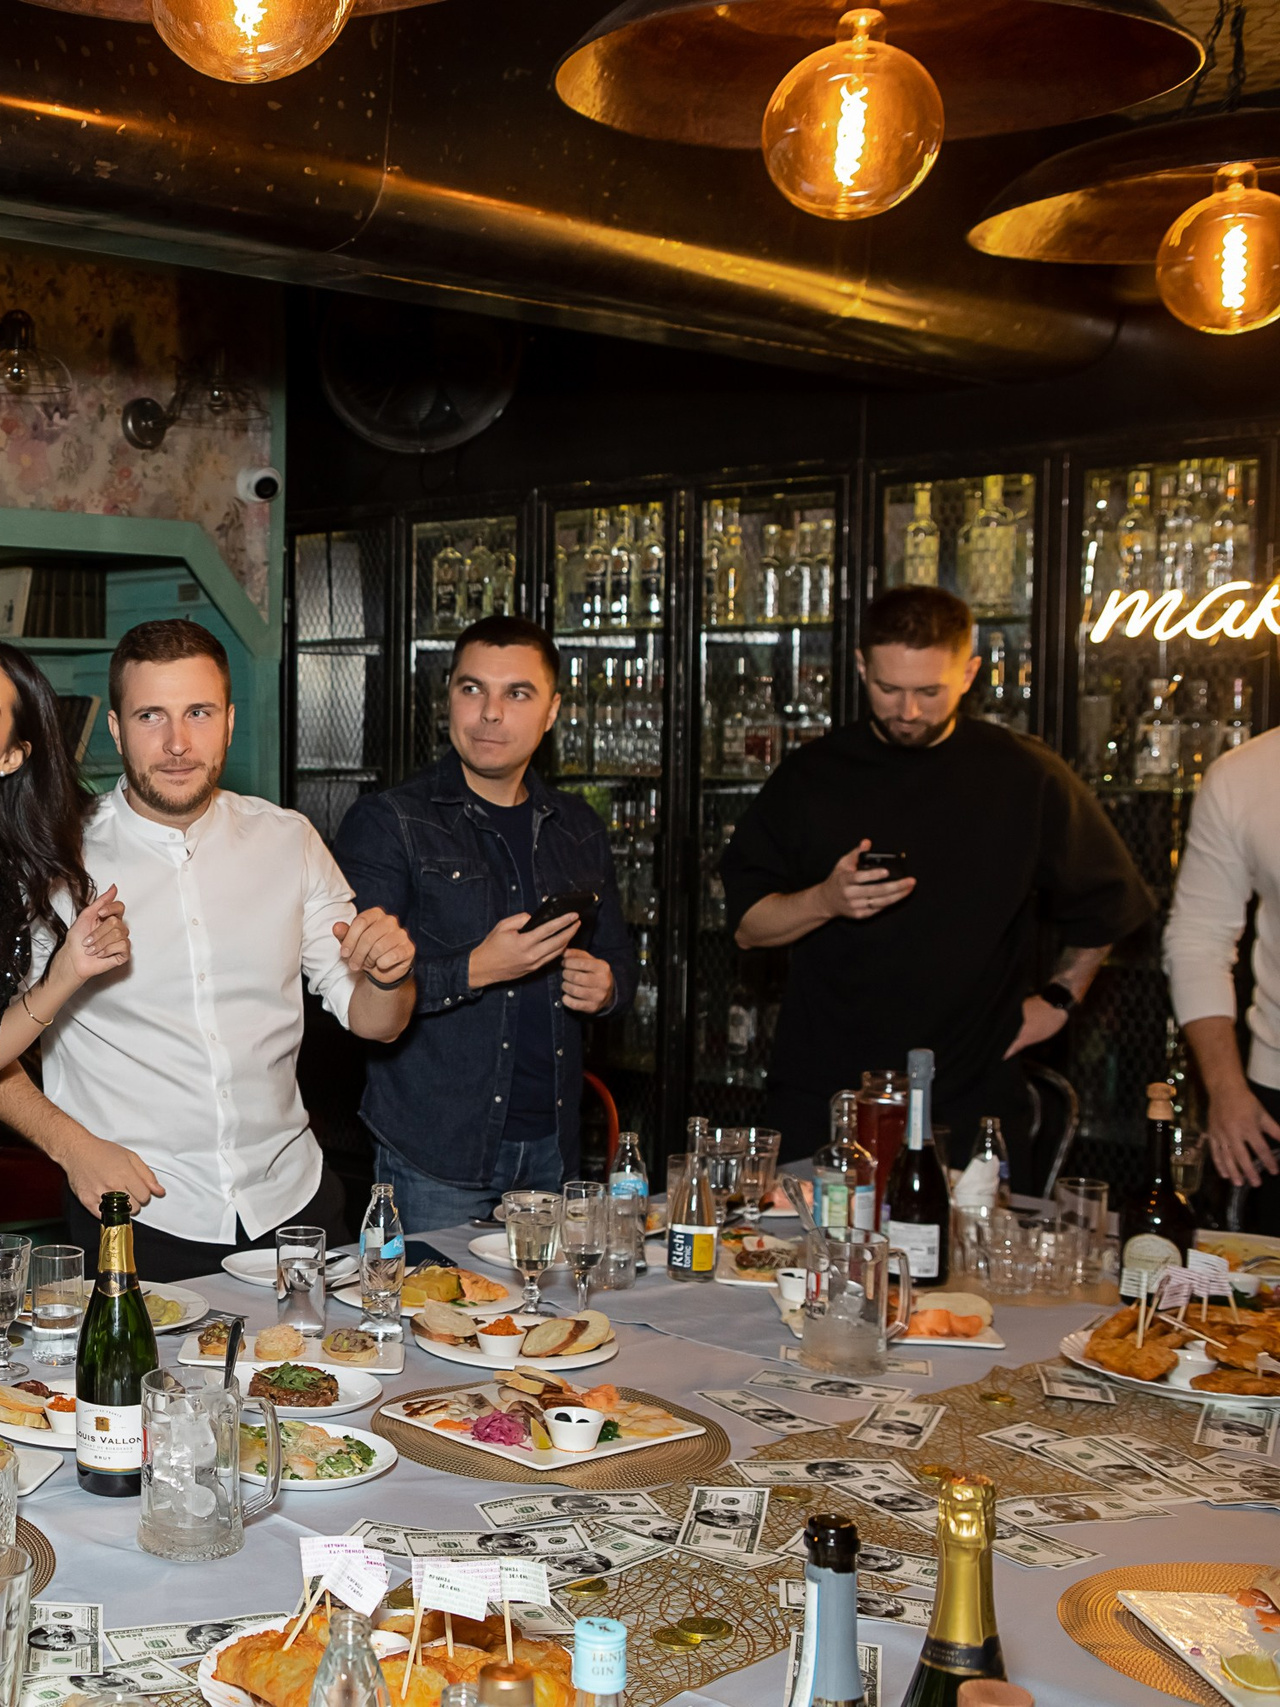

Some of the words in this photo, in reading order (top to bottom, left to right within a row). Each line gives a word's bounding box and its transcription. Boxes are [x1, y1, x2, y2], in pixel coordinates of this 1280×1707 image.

[671, 1233, 685, 1267] Rich
[683, 1245, 692, 1268] tonic
[591, 1666, 614, 1676] GIN
